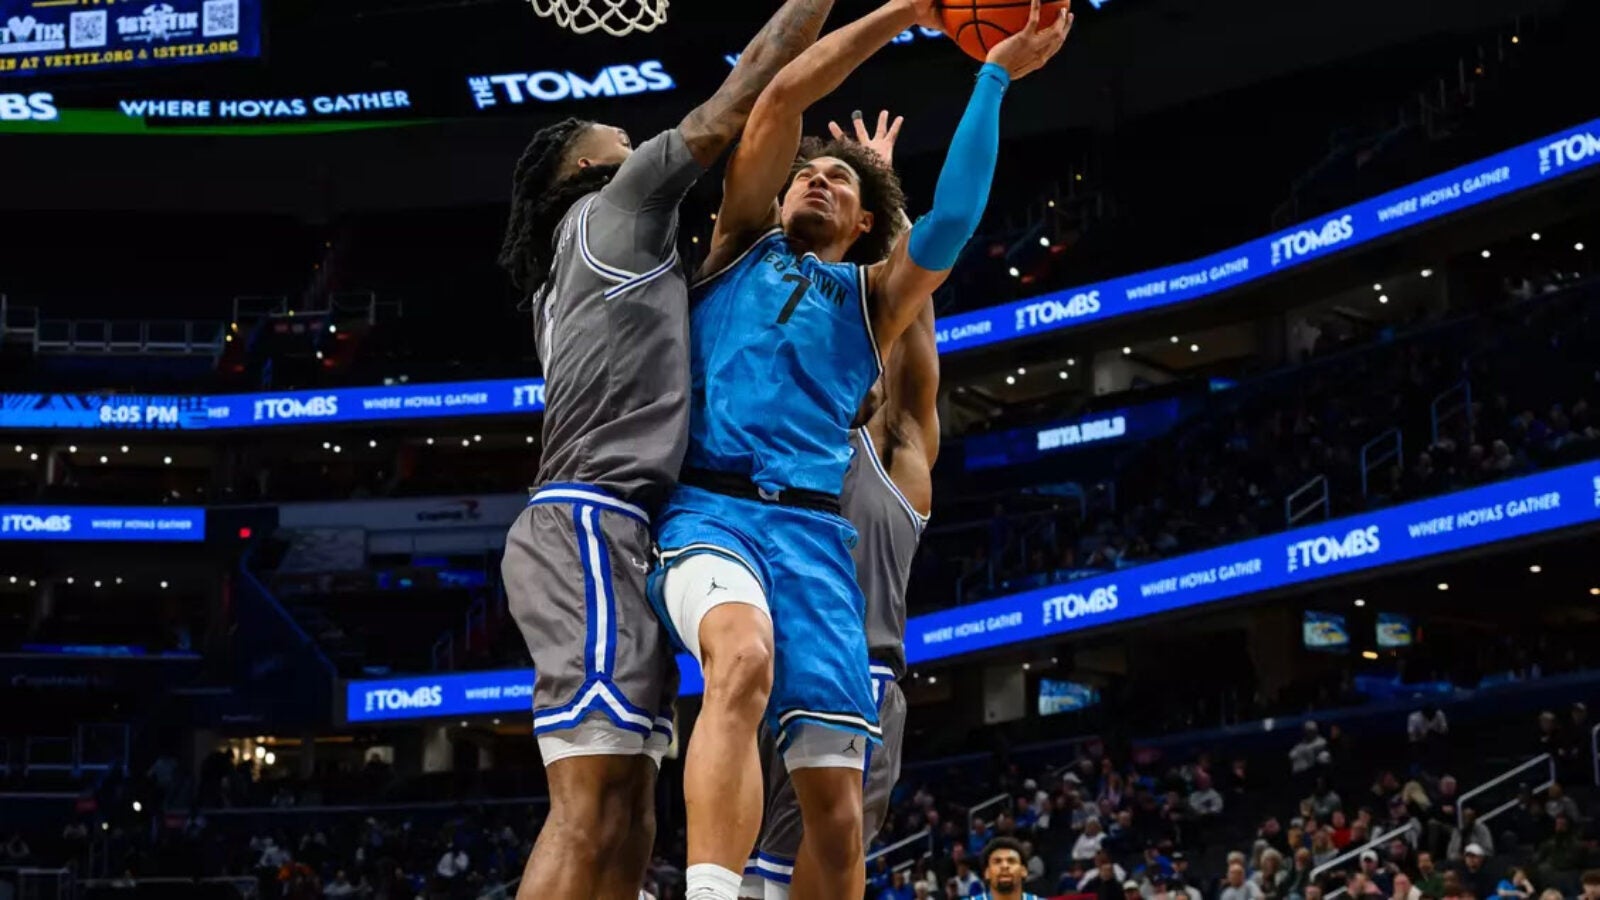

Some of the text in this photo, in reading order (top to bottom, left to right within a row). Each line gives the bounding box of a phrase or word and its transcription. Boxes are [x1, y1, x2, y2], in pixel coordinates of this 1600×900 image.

[35, 23, 65, 41] TIX
[21, 57, 40, 69] AT
[468, 59, 674, 109] THE TOMBS
[120, 90, 409, 117] WHERE HOYAS GATHER
[1378, 166, 1510, 221] WHERE HOYAS GATHER
[1281, 214, 1354, 259] TOMBS
[1127, 257, 1249, 299] WHERE HOYAS GATHER
[776, 272, 813, 326] 7
[1026, 290, 1101, 326] TOMBS
[951, 321, 991, 340] GATHER
[98, 404, 179, 424] 8:05 PM
[265, 395, 338, 419] TOMBS
[363, 393, 488, 409] WHERE HOYAS GATHER
[10, 514, 72, 532] TOMBS
[1409, 492, 1560, 537] WHERE HOYAS GATHER
[1298, 525, 1380, 567] TOMBS
[1141, 559, 1261, 596] WHERE HOYAS GATHER
[1053, 584, 1119, 621] TOMBS
[923, 612, 1022, 643] WHERE HOYAS GATHER
[377, 685, 442, 710] TOMBS
[465, 687, 501, 699] WHERE
